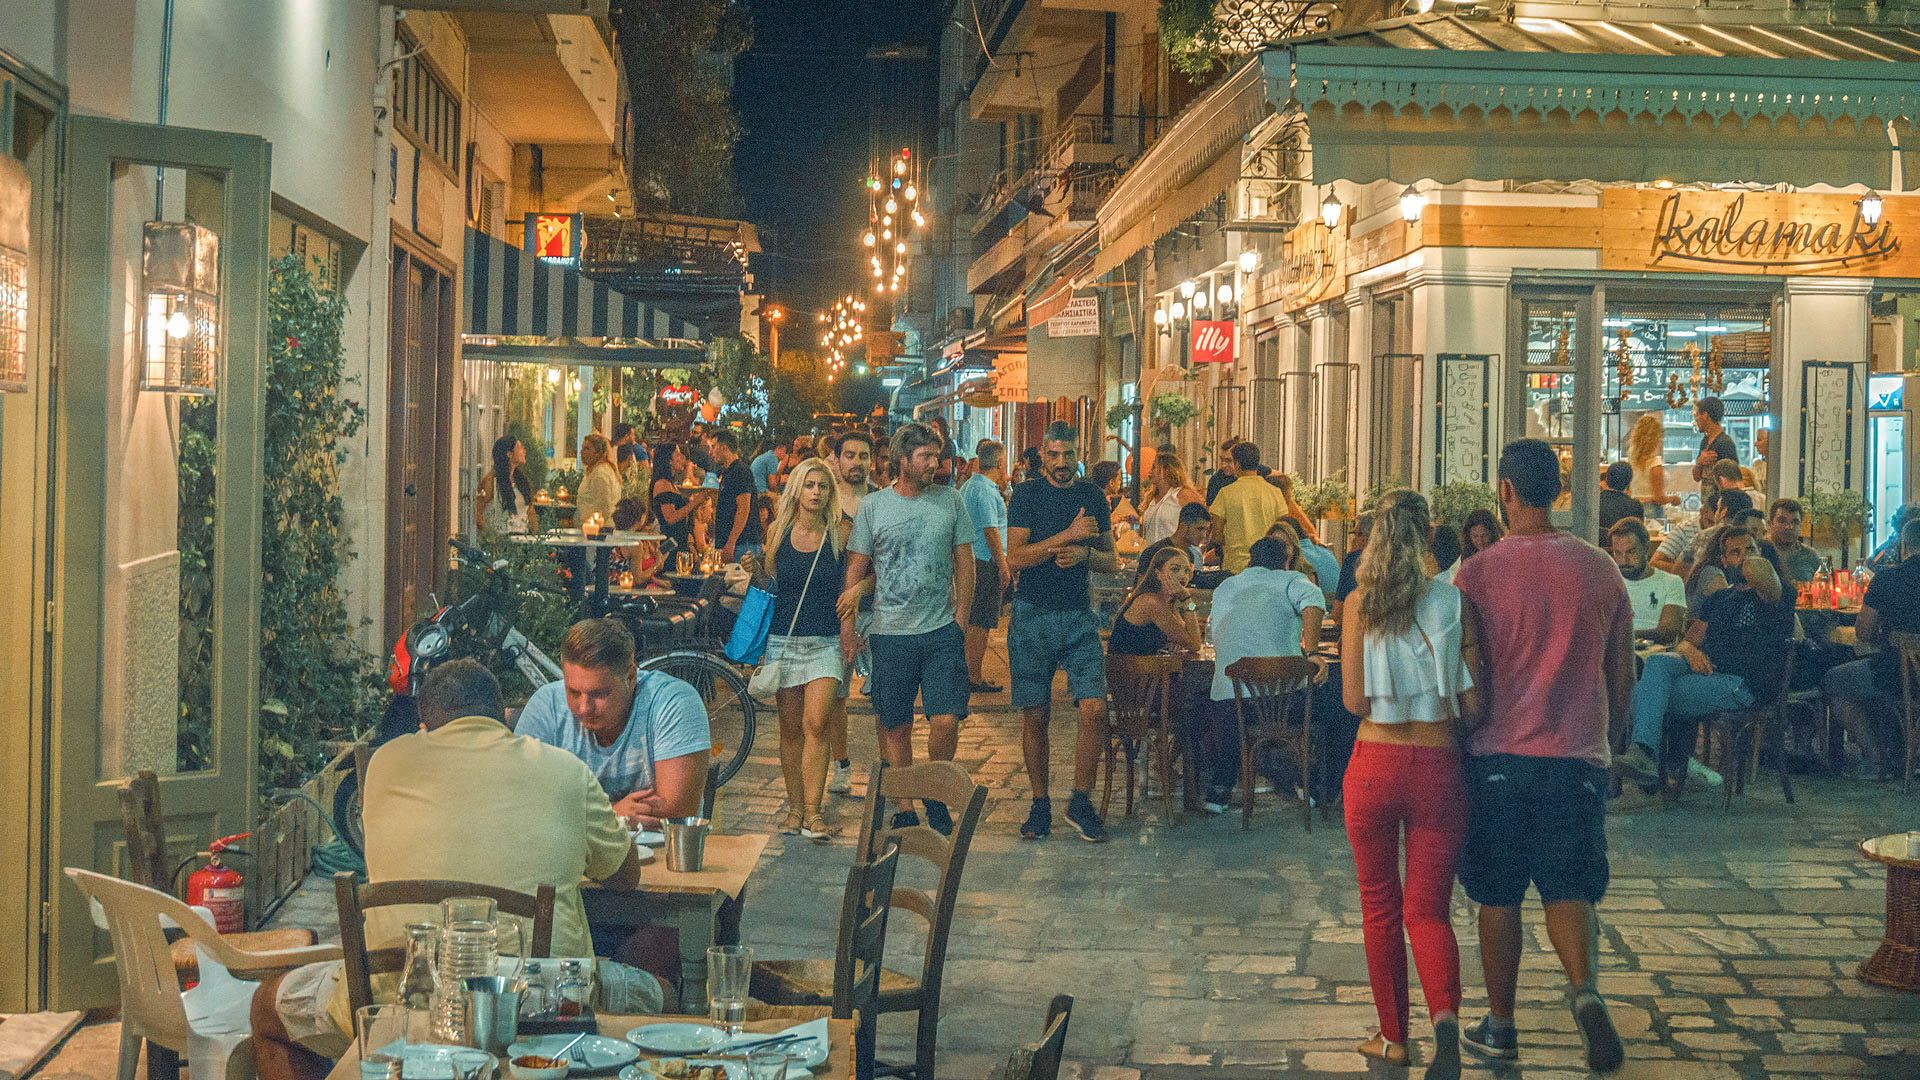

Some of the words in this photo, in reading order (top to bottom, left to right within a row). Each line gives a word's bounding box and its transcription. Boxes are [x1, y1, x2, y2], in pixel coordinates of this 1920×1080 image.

[1659, 191, 1898, 258] kalamaki
[1070, 299, 1097, 308] ΛΑΣΤΕΙΟ
[1195, 326, 1230, 357] illy
